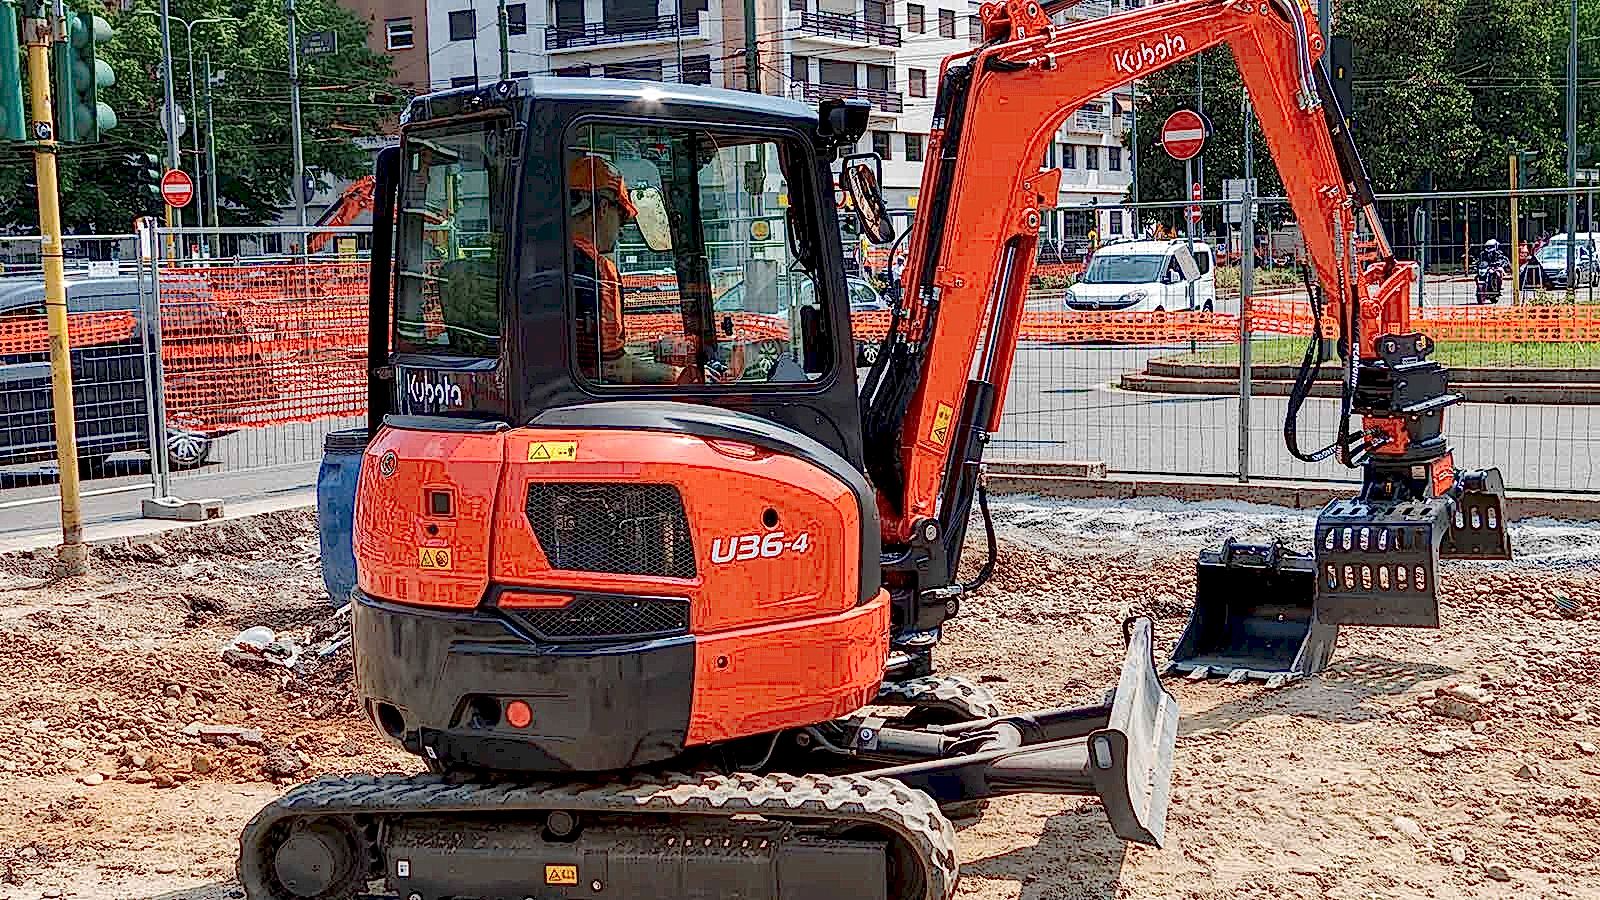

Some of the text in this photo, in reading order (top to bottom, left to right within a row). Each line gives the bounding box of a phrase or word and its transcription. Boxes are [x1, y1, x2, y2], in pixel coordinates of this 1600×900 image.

[1114, 32, 1187, 73] Kubota
[406, 373, 463, 406] Kubota
[711, 531, 809, 564] U36-4
